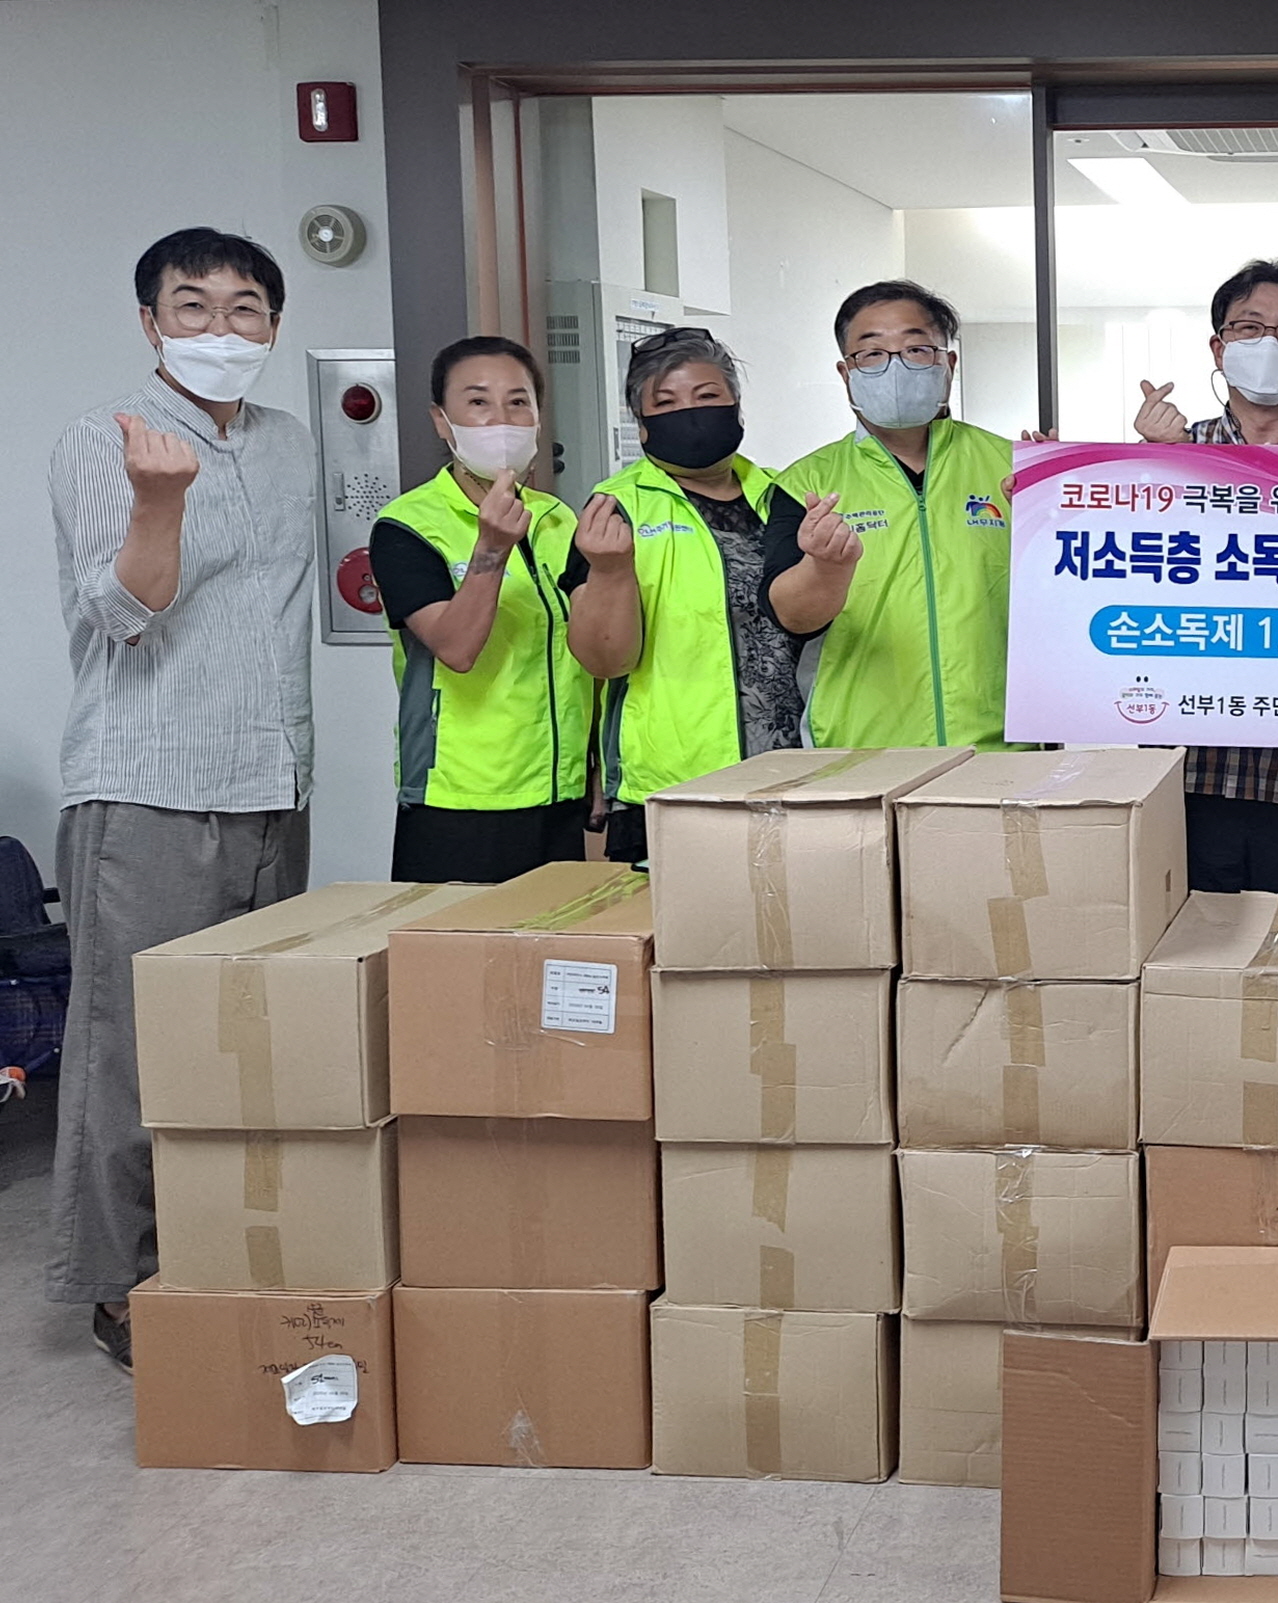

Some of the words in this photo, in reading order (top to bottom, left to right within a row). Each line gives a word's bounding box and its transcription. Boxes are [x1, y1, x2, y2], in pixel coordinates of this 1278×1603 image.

[1060, 483, 1175, 513] 코로나19
[1183, 485, 1261, 514] 극복을
[1054, 530, 1202, 585] 저소득층
[1106, 611, 1244, 652] 손소독제
[1127, 704, 1156, 715] 선부1동
[1178, 694, 1247, 717] 선부1동
